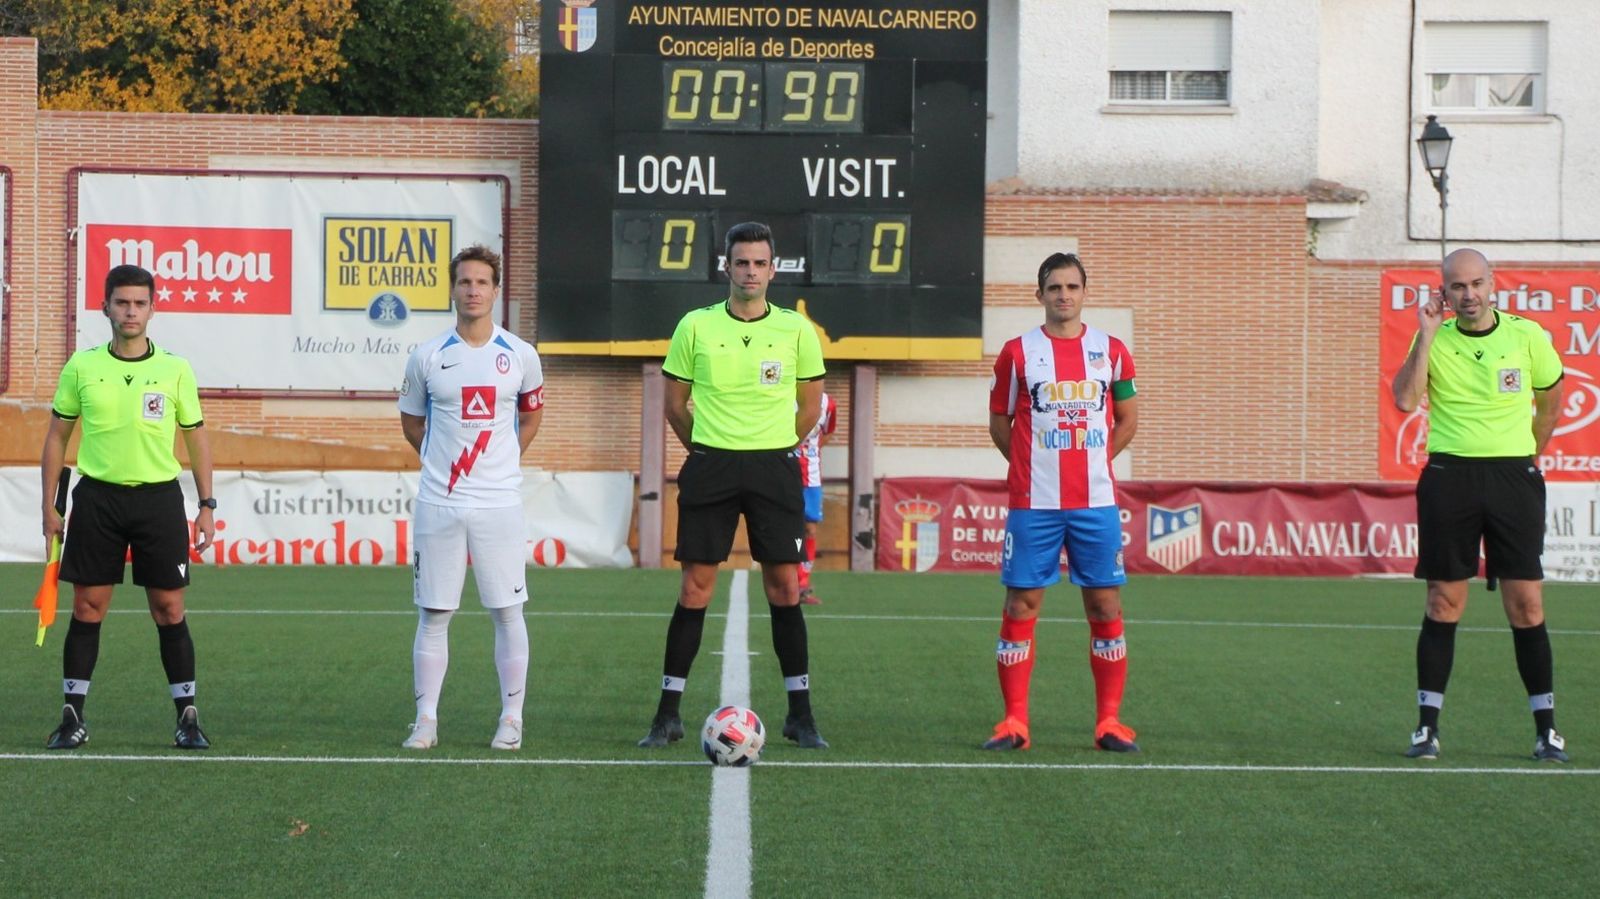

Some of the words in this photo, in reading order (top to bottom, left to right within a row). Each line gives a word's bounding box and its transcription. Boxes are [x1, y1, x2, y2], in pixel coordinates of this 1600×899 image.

[628, 6, 781, 27] AYUNTAMIENTO
[785, 8, 812, 27] DE
[818, 9, 977, 30] NAVALCARNERO
[659, 36, 756, 62] Concejalía
[761, 38, 785, 57] de
[790, 38, 875, 62] Deportes
[618, 155, 726, 196] LOCAL
[802, 157, 905, 198] VISIT.
[339, 226, 437, 264] SOLAN
[659, 219, 696, 270] 0
[869, 222, 906, 273] 0
[105, 238, 274, 282] Mahou
[339, 266, 360, 286] DE
[368, 266, 437, 287] CABRAS
[292, 336, 356, 355] Mucho
[362, 337, 402, 355] Más
[1043, 382, 1098, 402] 100
[1076, 427, 1105, 450] PARK
[953, 528, 977, 542] DE
[1005, 532, 1014, 560] 9
